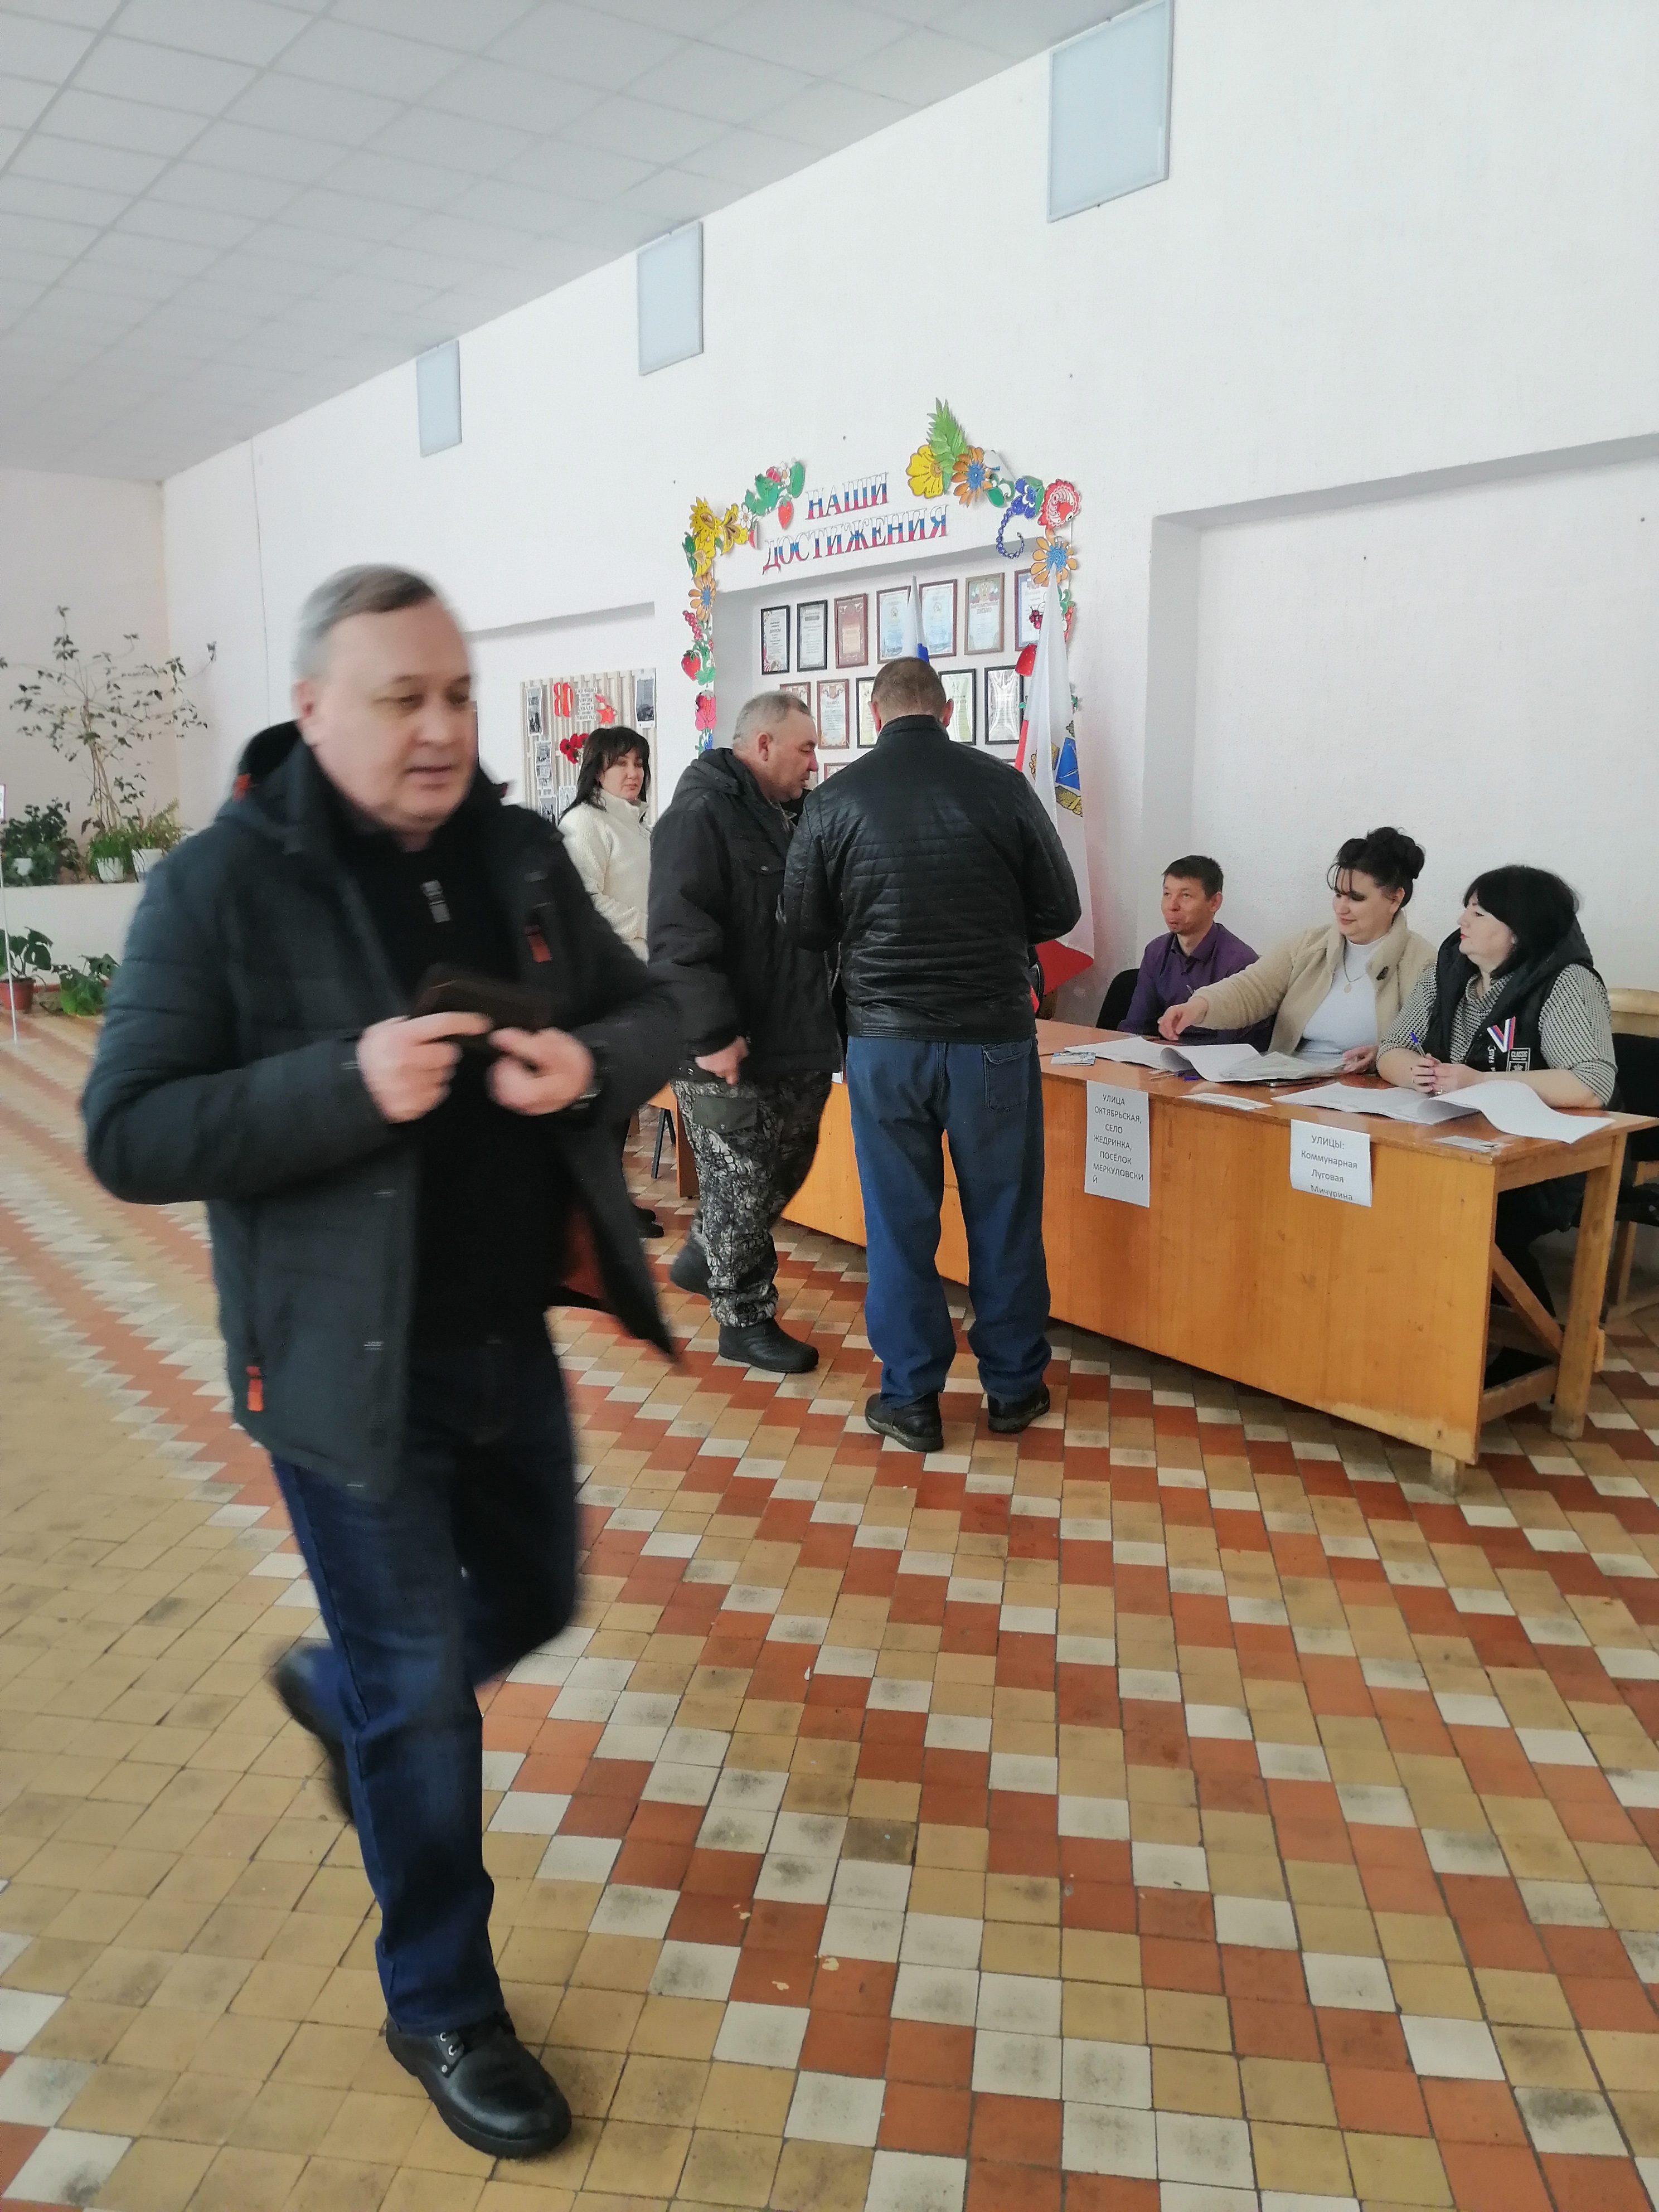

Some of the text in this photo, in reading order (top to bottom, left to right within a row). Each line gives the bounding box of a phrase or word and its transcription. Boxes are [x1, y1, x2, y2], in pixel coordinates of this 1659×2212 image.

[805, 472, 889, 520] НАШИ
[762, 505, 949, 575] ДОСТИЖЕНИЯ
[553, 682, 573, 717] 80
[1102, 1094, 1125, 1105] УЛИЦА
[1094, 1106, 1142, 1124] ОКТЯБРЬСКАЯ,
[1105, 1124, 1123, 1134] СЕЛО
[1094, 1134, 1132, 1151] ЖЕДРИНКА,
[1312, 1135, 1345, 1149] УЛИЦЫ:
[1100, 1151, 1132, 1165] ПОСЁЛОК
[1301, 1150, 1357, 1168] Коммунарная
[1093, 1163, 1143, 1181] МЕРКУЛОВСКИ
[1311, 1169, 1344, 1183] Луговая
[1311, 1185, 1352, 1201] Мичурина
